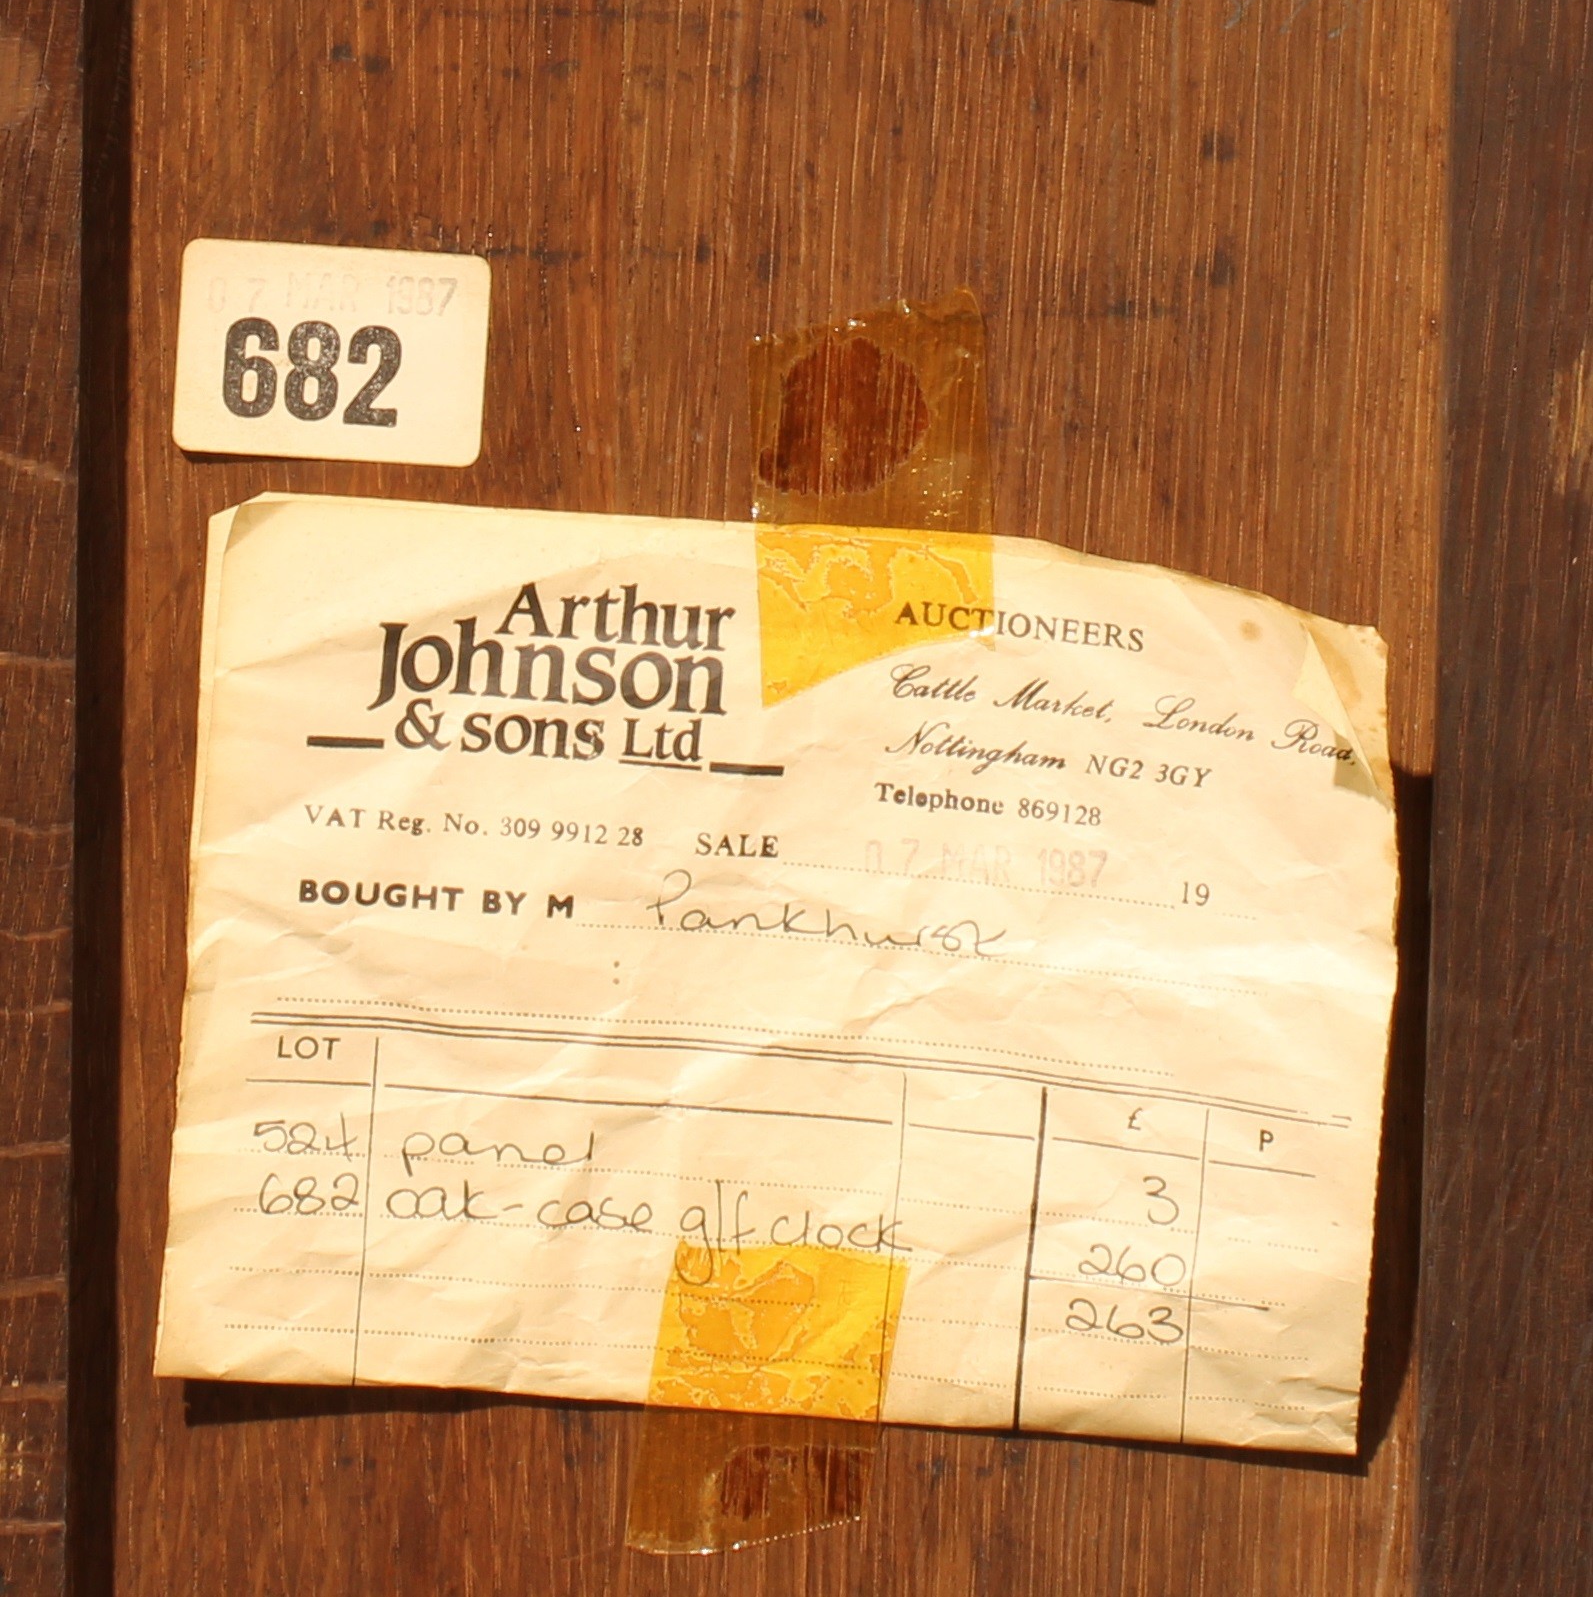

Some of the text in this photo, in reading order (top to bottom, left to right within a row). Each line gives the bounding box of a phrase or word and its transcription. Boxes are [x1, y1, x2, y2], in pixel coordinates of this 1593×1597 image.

[285, 270, 361, 315] MAR
[385, 276, 459, 317] 1987
[221, 316, 403, 429] 682
[494, 581, 736, 652] Arthur
[893, 600, 1145, 653] AUCTIONEERS
[366, 615, 728, 716] Johnson
[393, 697, 703, 763] & sons Ltd
[889, 663, 1357, 767] Cattle Market, London Road,
[884, 720, 1214, 790] Nottingham NG2 3GY
[873, 781, 1103, 827] Telephone 869128
[303, 804, 781, 860] VAT Reg. No. 309 9912 28 SALE
[298, 878, 576, 920] BOUGHT BY M
[942, 843, 1012, 886] MAR
[1036, 847, 1109, 889] 1987
[1181, 881, 1211, 908] 19
[277, 1034, 342, 1061] LOT
[252, 1111, 596, 1178] 524 panel
[1127, 1107, 1143, 1131] £
[1258, 1128, 1275, 1153] P
[257, 1171, 360, 1216] 682
[770, 1209, 914, 1254] clock
[1142, 1175, 1180, 1226] 3
[1077, 1242, 1187, 1287] 260
[1064, 1297, 1184, 1344] 263
